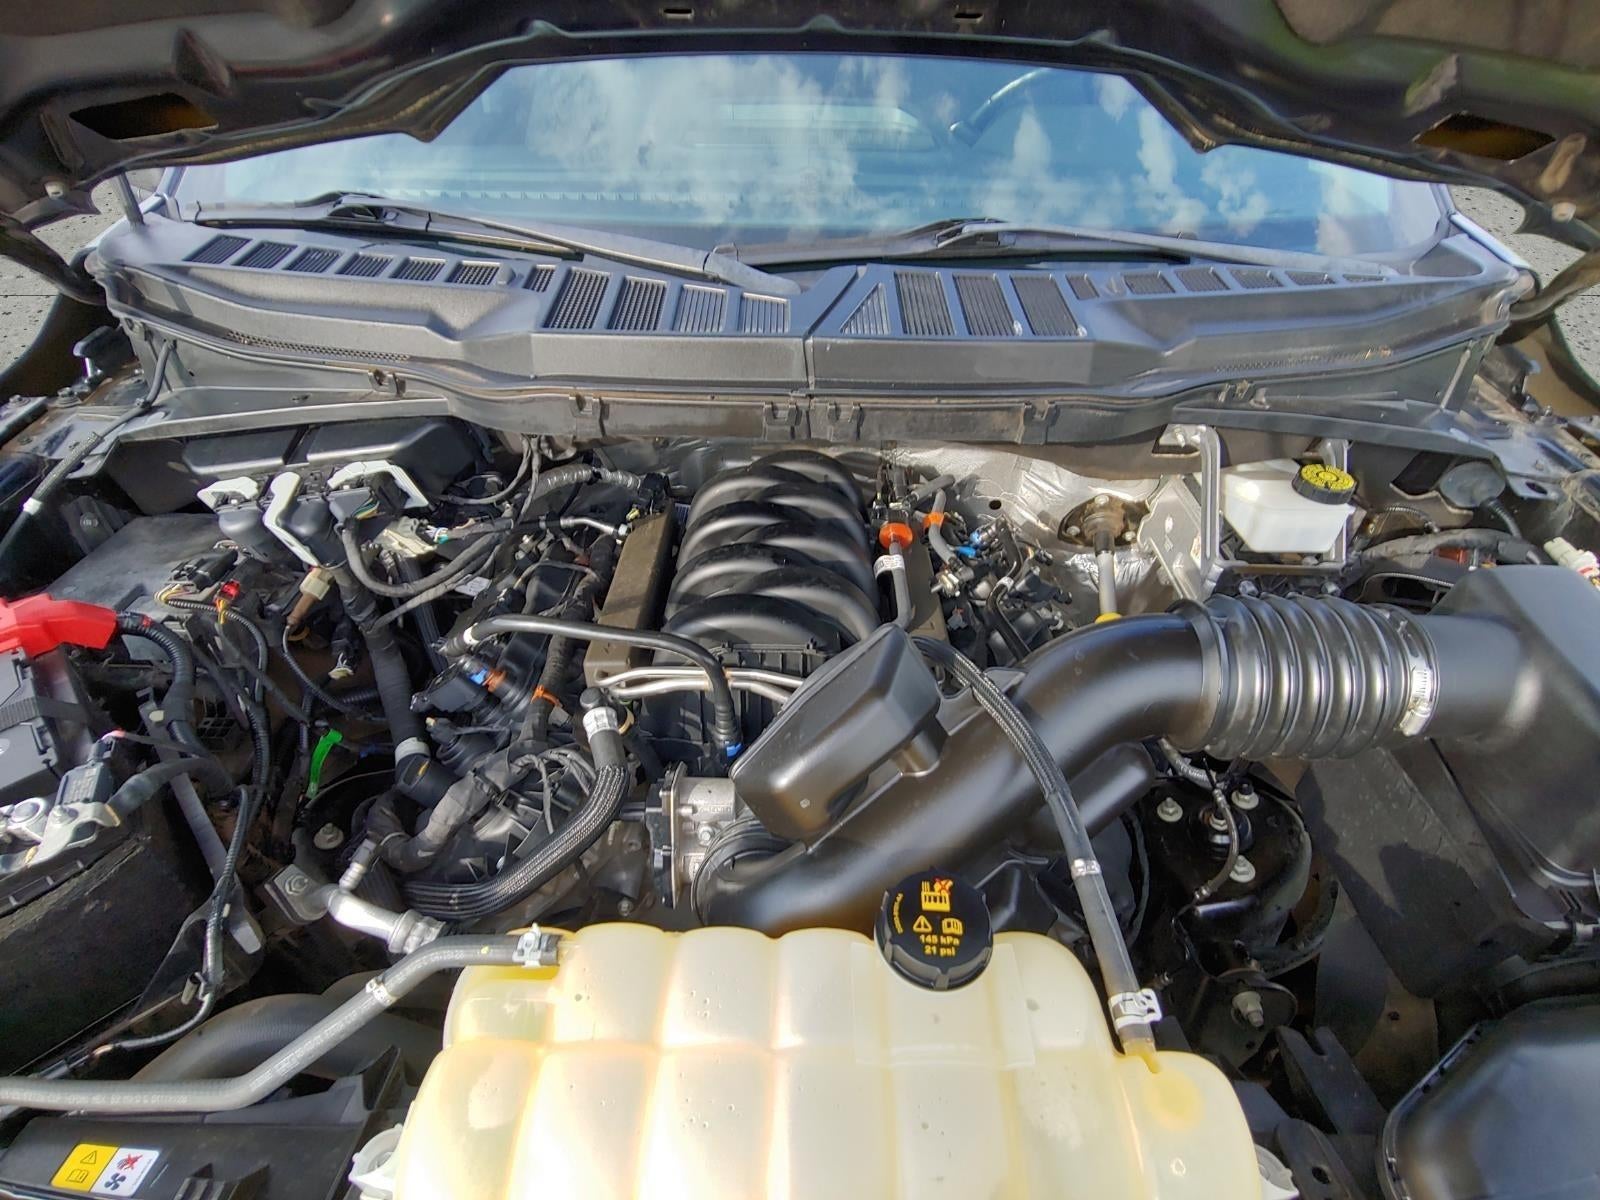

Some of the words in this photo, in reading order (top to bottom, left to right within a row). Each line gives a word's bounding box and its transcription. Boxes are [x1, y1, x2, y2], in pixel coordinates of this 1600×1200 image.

[940, 935, 960, 946] kPa
[924, 945, 937, 955] 21
[940, 946, 956, 957] psi
